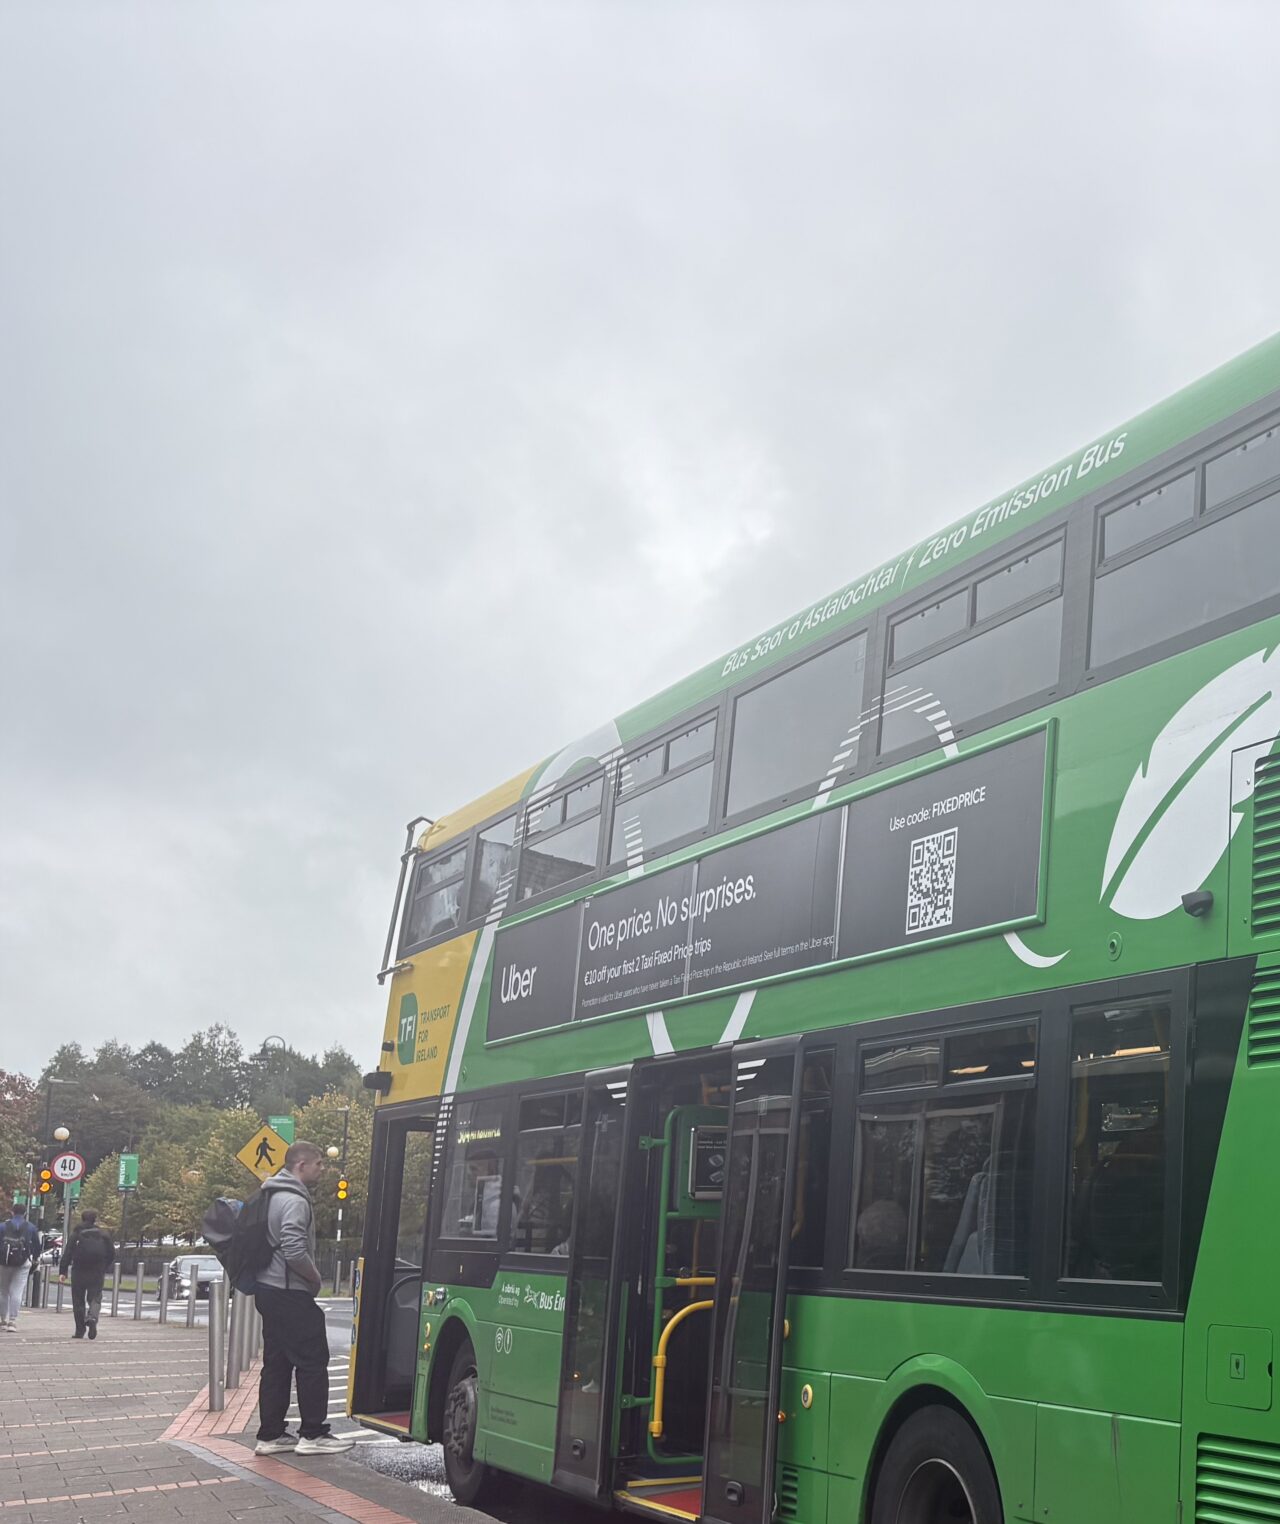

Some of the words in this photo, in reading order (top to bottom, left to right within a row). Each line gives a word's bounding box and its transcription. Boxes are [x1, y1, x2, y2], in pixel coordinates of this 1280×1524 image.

[721, 647, 752, 677] Bus
[751, 626, 789, 660] Saor
[788, 614, 804, 640] ó
[800, 556, 905, 634] Astaíochtaí
[918, 525, 968, 569] Zero
[970, 463, 1073, 539] Emission
[1076, 432, 1128, 480] Bus
[889, 816, 906, 832] Use
[906, 807, 931, 826] code:
[932, 785, 986, 818] FIXEDPRICE
[588, 921, 615, 951] One
[616, 908, 653, 951] price.
[656, 895, 678, 930] No
[681, 874, 756, 923] surprises.
[584, 968, 597, 985] €10
[597, 964, 607, 982] off
[606, 964, 622, 983] your
[622, 957, 635, 976] first
[635, 956, 641, 972] 2
[641, 952, 654, 970] Taxi
[653, 946, 674, 966] Fixed
[673, 942, 694, 961] Price
[694, 937, 712, 957] trips
[764, 950, 773, 961] See
[800, 940, 808, 951] the
[809, 937, 823, 949] Uber
[501, 963, 537, 1004] Uber
[420, 1004, 451, 1024] TRANSPORT
[400, 1014, 417, 1043] TFI
[417, 1030, 429, 1043] FOR
[416, 1045, 438, 1062] IRELAND
[60, 1158, 76, 1171] 40
[539, 1292, 554, 1310] Bus
